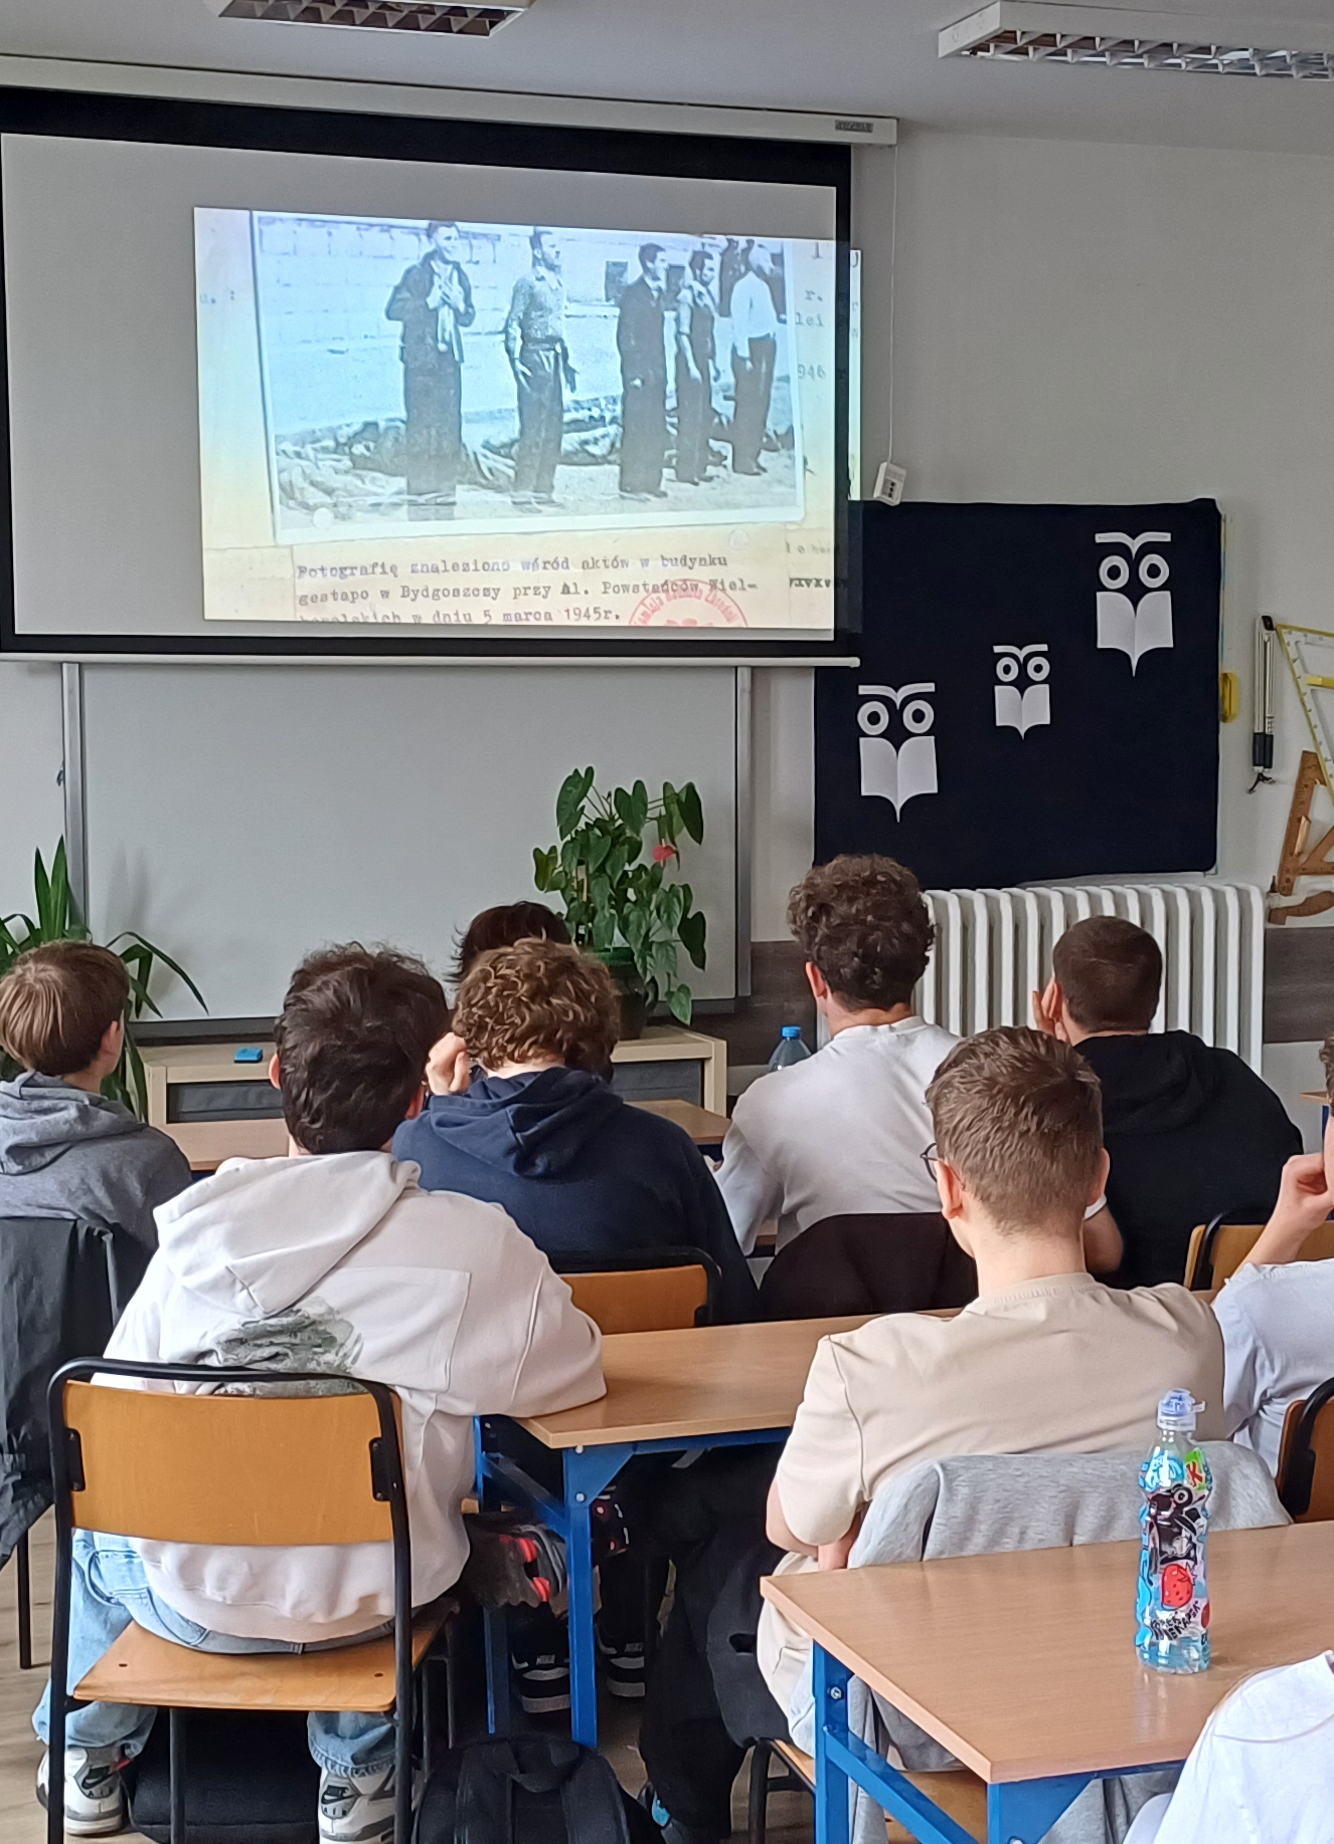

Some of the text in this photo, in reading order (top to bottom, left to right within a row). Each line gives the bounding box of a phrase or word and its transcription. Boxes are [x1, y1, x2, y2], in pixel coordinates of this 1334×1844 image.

[640, 558, 650, 569] w
[380, 589, 391, 599] w
[512, 584, 552, 600] przy
[560, 581, 589, 595] Al.
[432, 609, 473, 624] dniu
[483, 609, 492, 624] 5
[502, 610, 554, 623] marca
[563, 606, 620, 622] 1945r.
